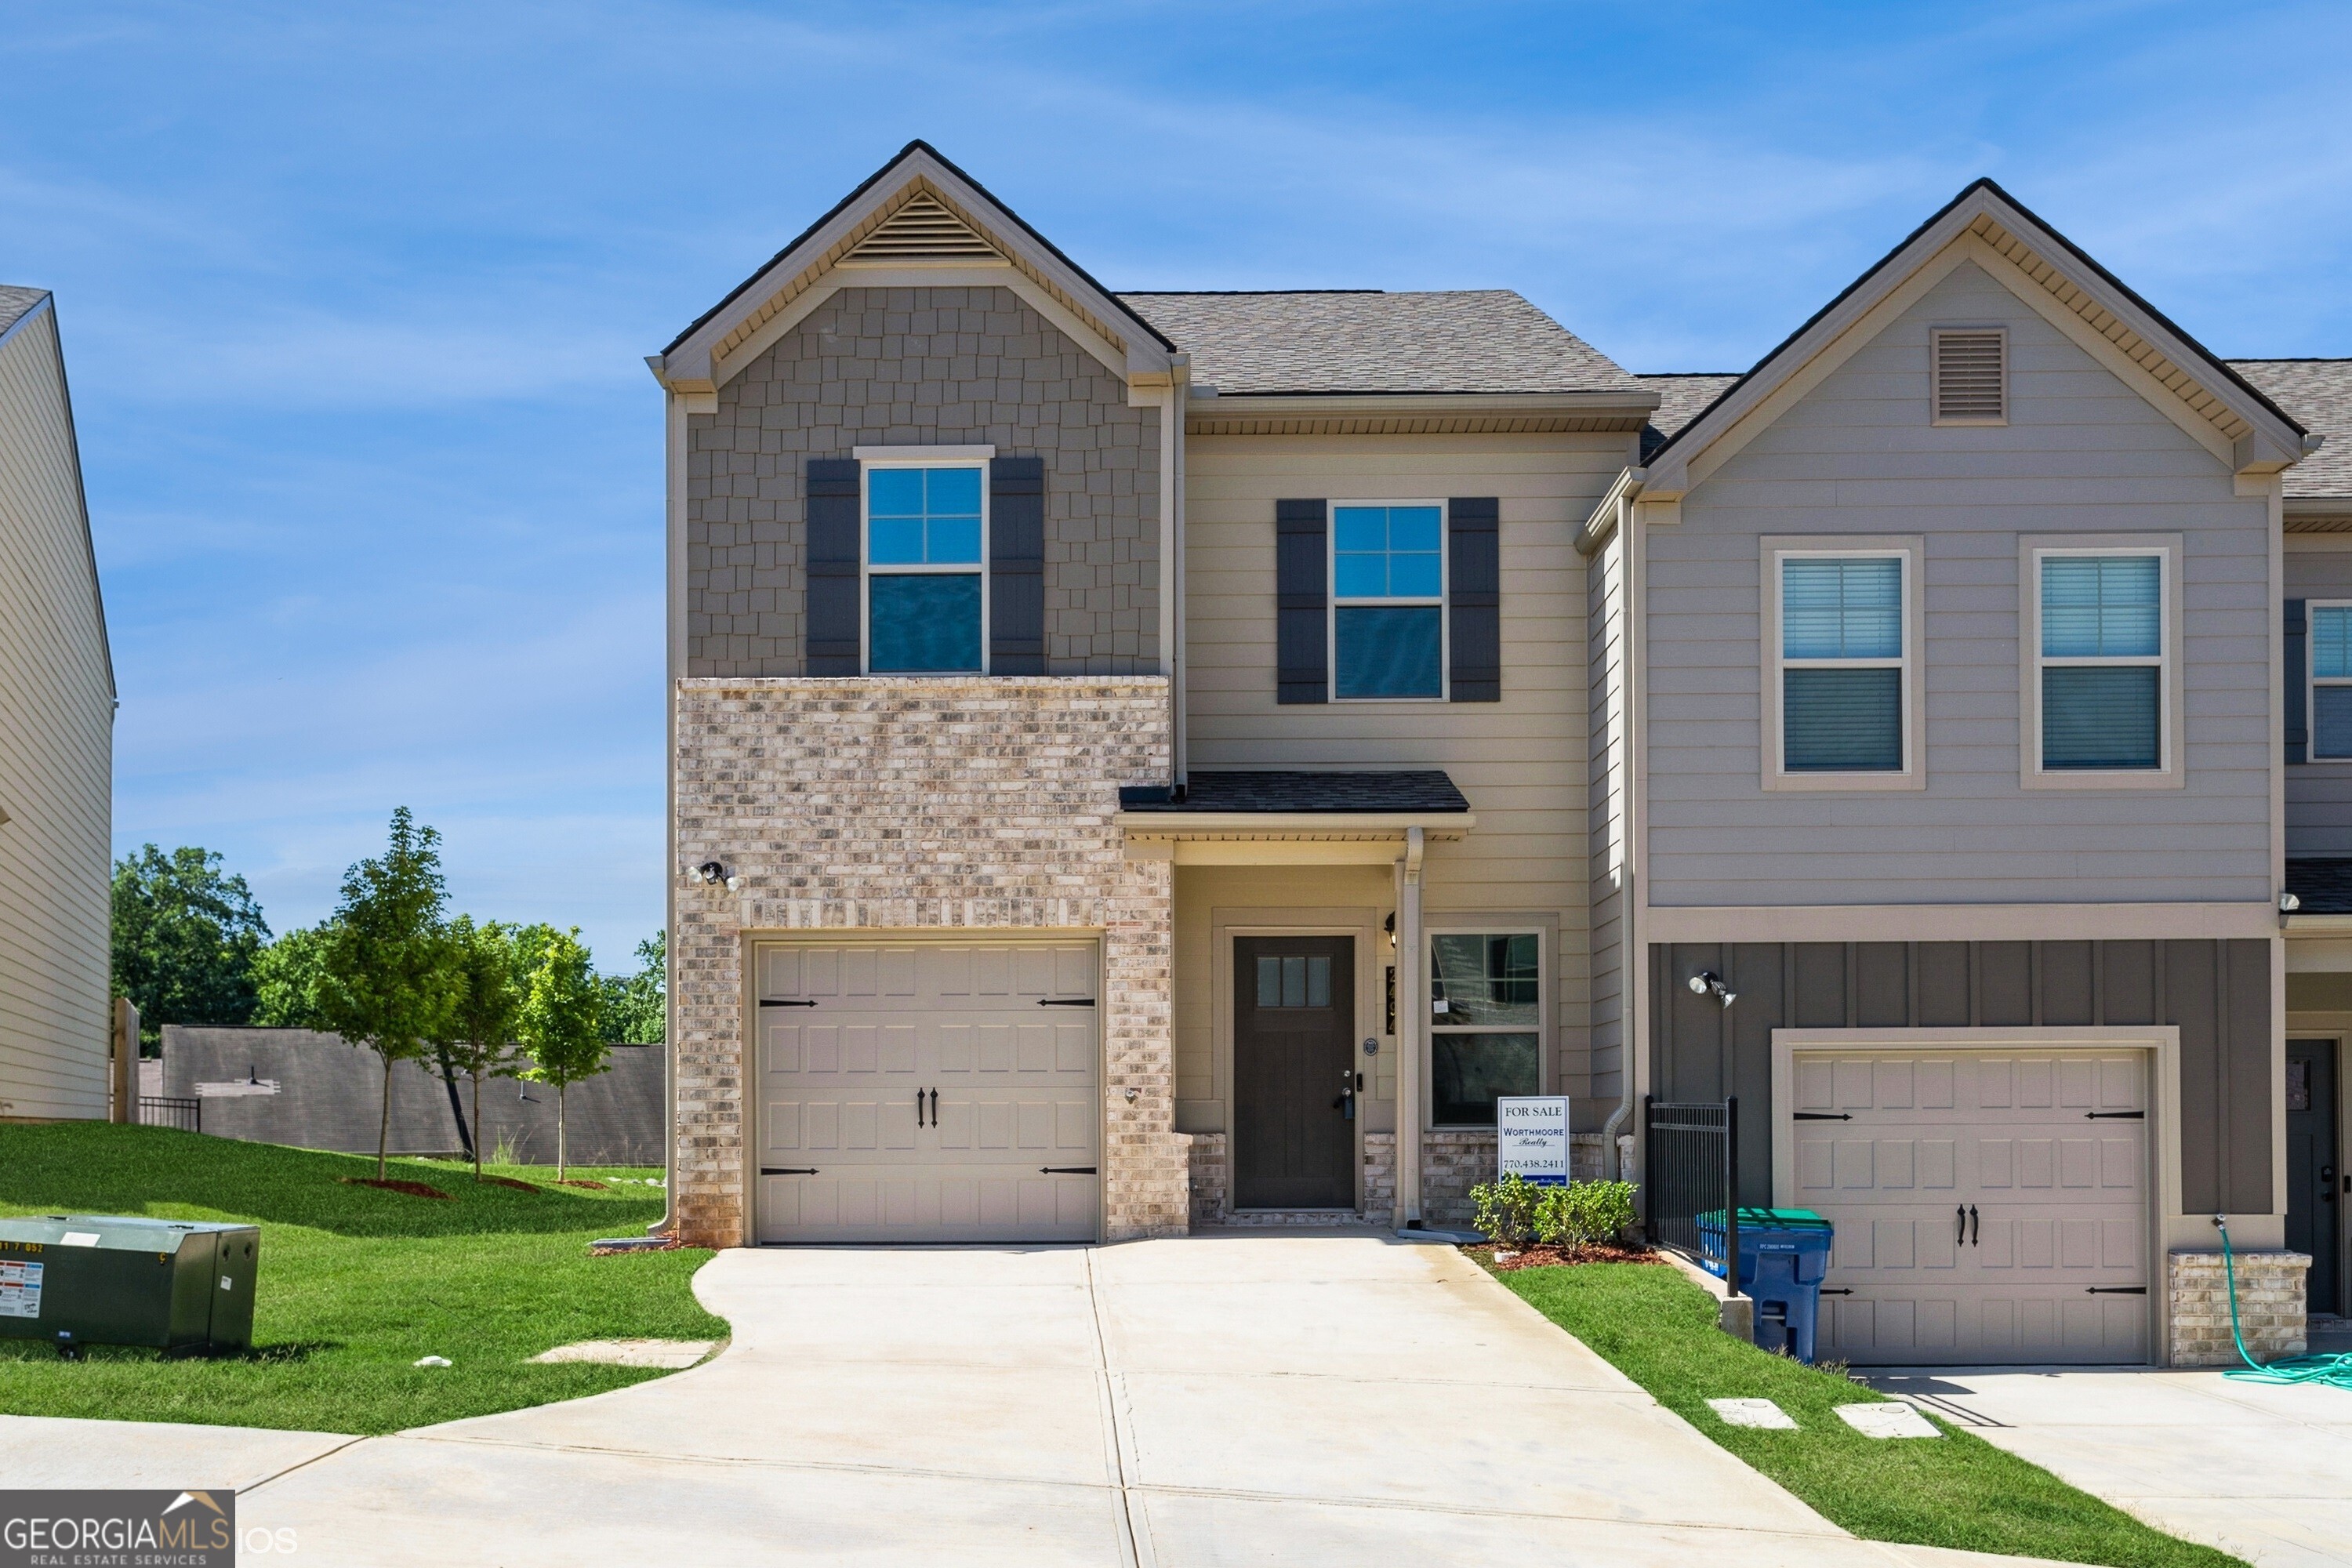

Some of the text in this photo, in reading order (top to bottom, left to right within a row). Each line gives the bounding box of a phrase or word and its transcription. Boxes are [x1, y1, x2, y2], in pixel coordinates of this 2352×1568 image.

[1505, 1106, 1563, 1117] FOR SALE
[1503, 1127, 1564, 1137] WORTHMOORE
[1504, 1160, 1564, 1168] 770.438.2411
